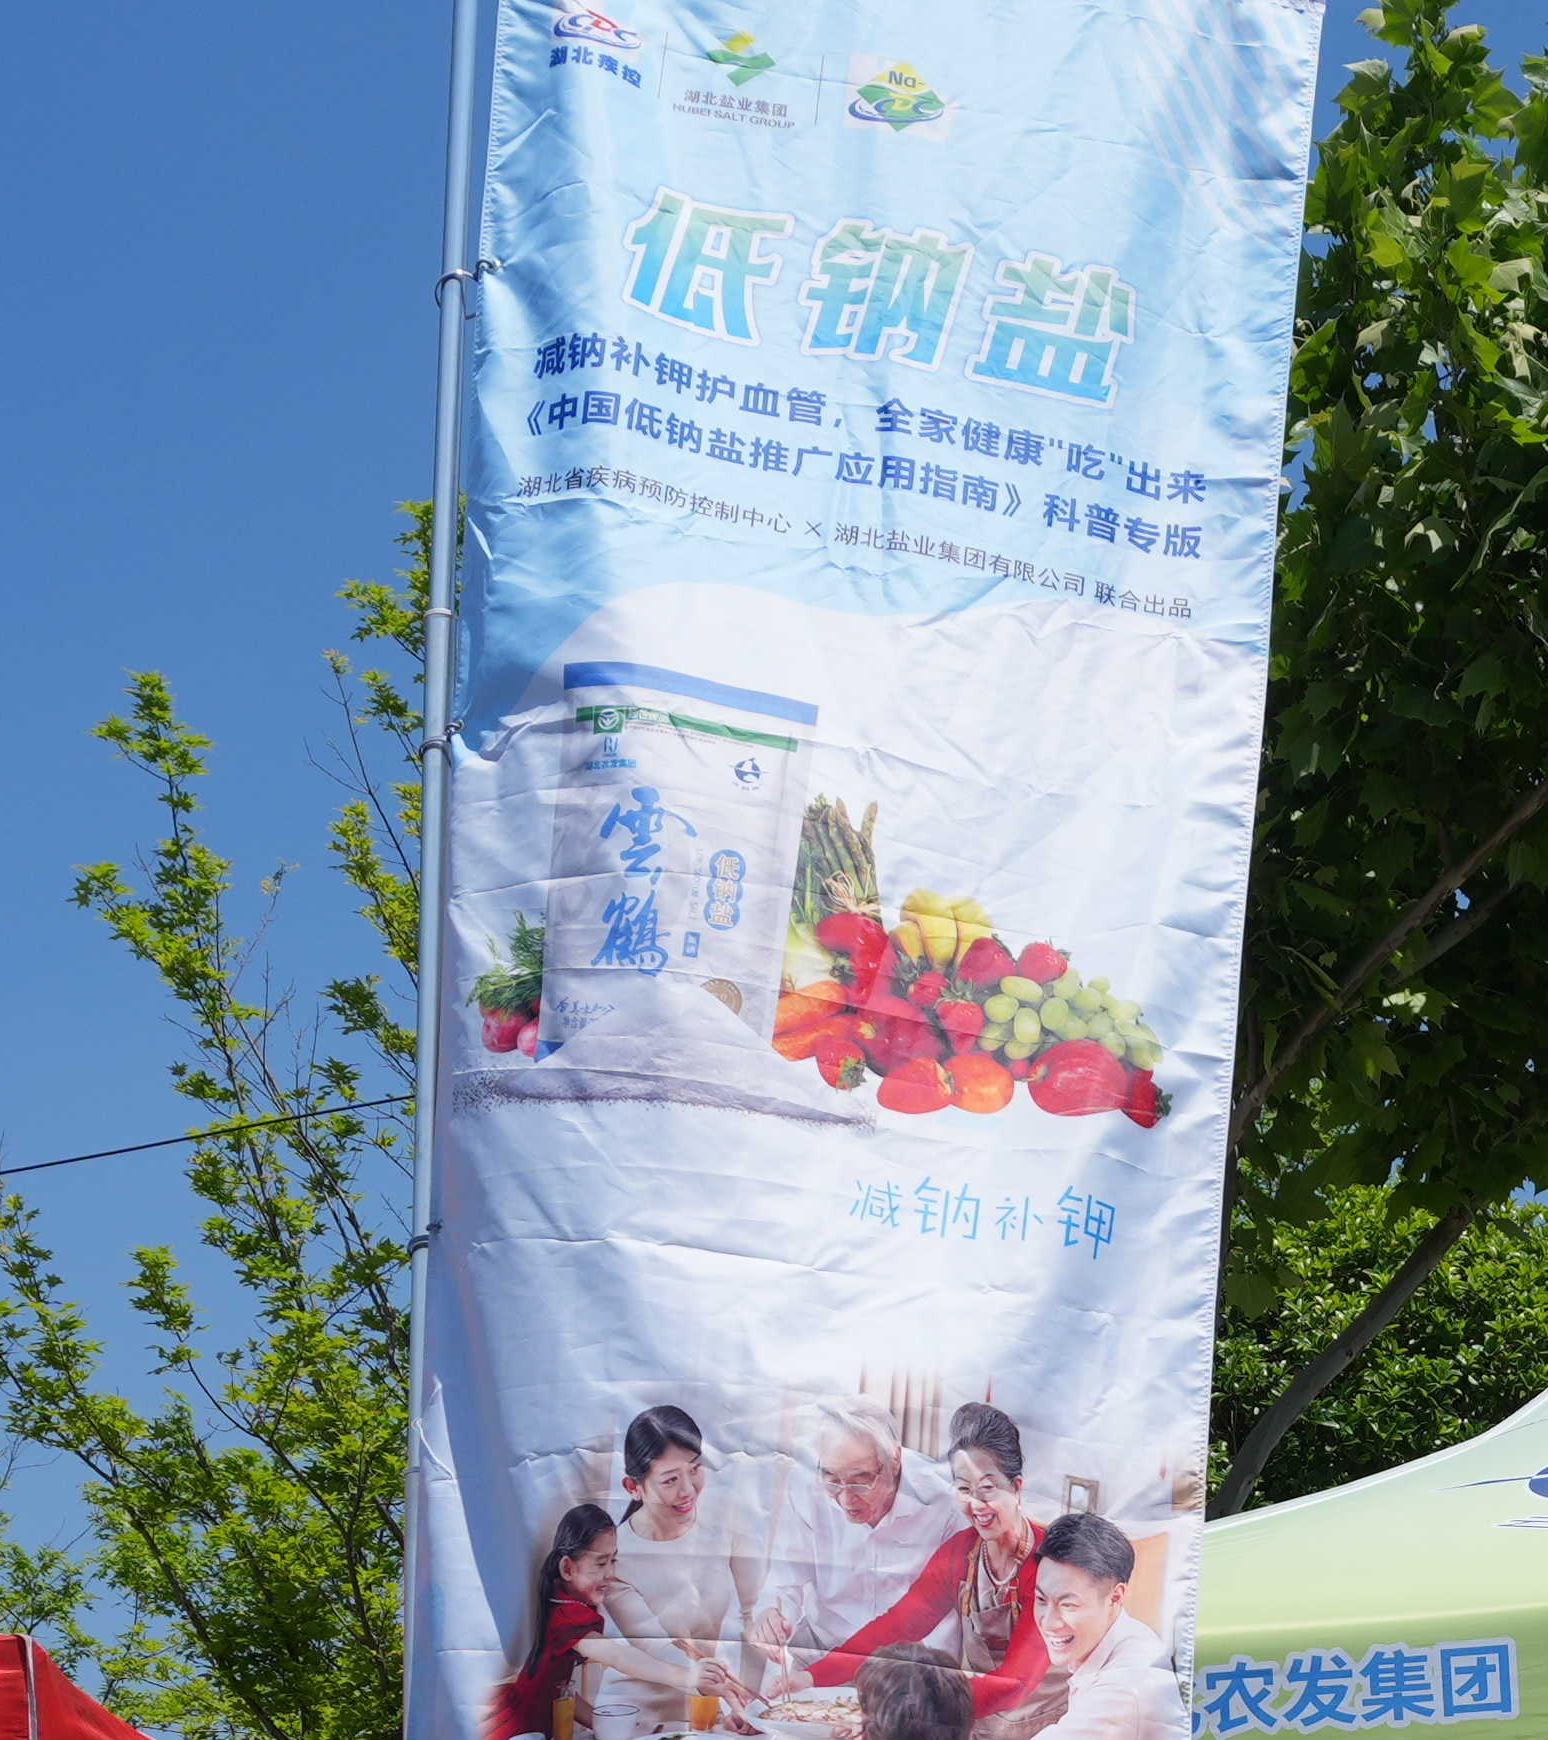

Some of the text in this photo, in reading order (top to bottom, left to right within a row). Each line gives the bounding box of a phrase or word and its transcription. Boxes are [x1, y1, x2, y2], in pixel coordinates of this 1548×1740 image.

[550, 46, 642, 89] 湖北疾控
[684, 88, 788, 118] 湖北盐业集团
[749, 115, 795, 129] GROUP
[624, 188, 1135, 407] 低钠盐
[516, 464, 1192, 619] 湖北省疾病预防控制中心 湖北盐业集团有限公司 联合出品
[849, 1175, 1116, 1260] 减钠补钾
[1192, 1640, 1512, 1737] 农发集团
